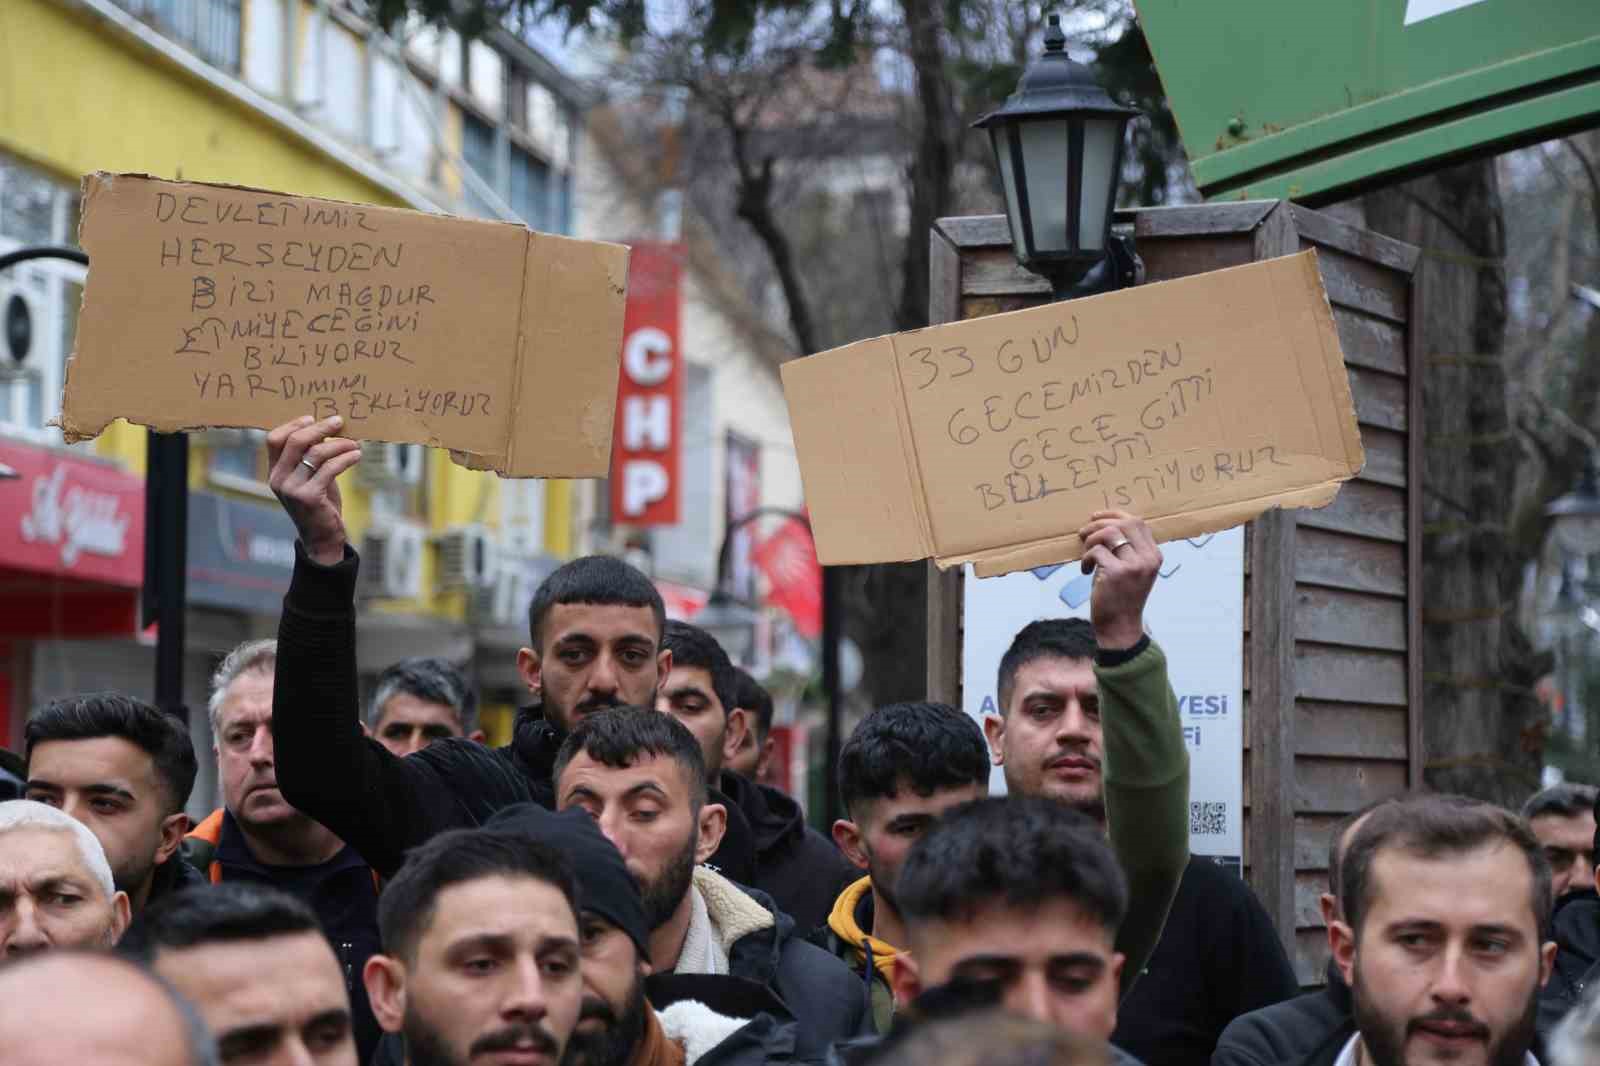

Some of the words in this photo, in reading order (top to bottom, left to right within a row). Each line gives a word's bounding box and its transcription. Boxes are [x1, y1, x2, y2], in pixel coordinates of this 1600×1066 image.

[909, 346, 975, 390] 33
[622, 326, 673, 516] CHP
[1009, 414, 1119, 470] GECE
